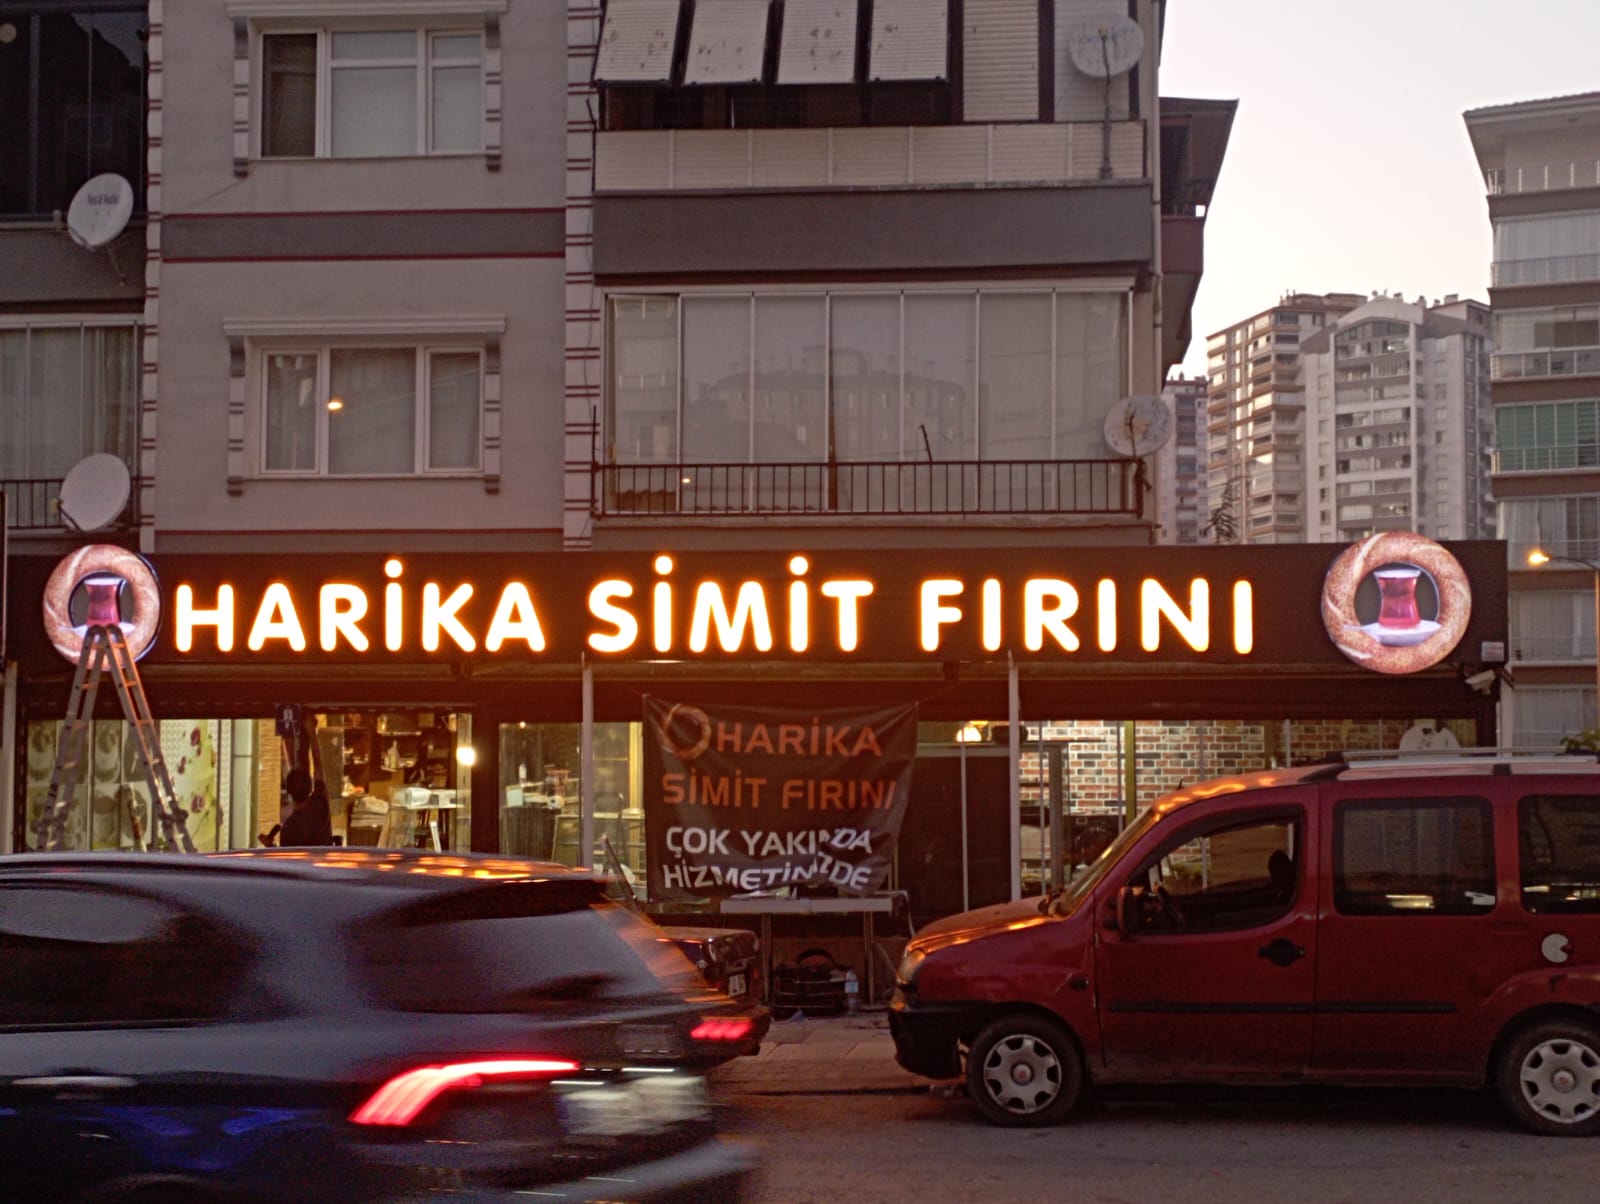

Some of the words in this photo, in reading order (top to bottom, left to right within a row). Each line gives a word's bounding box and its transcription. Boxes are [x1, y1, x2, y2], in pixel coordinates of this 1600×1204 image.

[174, 558, 547, 653] HARİKA
[586, 554, 875, 654] SİMİT
[919, 577, 1254, 654] FIRINI
[716, 717, 882, 757] HARİKA
[661, 768, 767, 808] SİMİT
[782, 780, 896, 810] FIRINI
[666, 827, 731, 858] ÇOK
